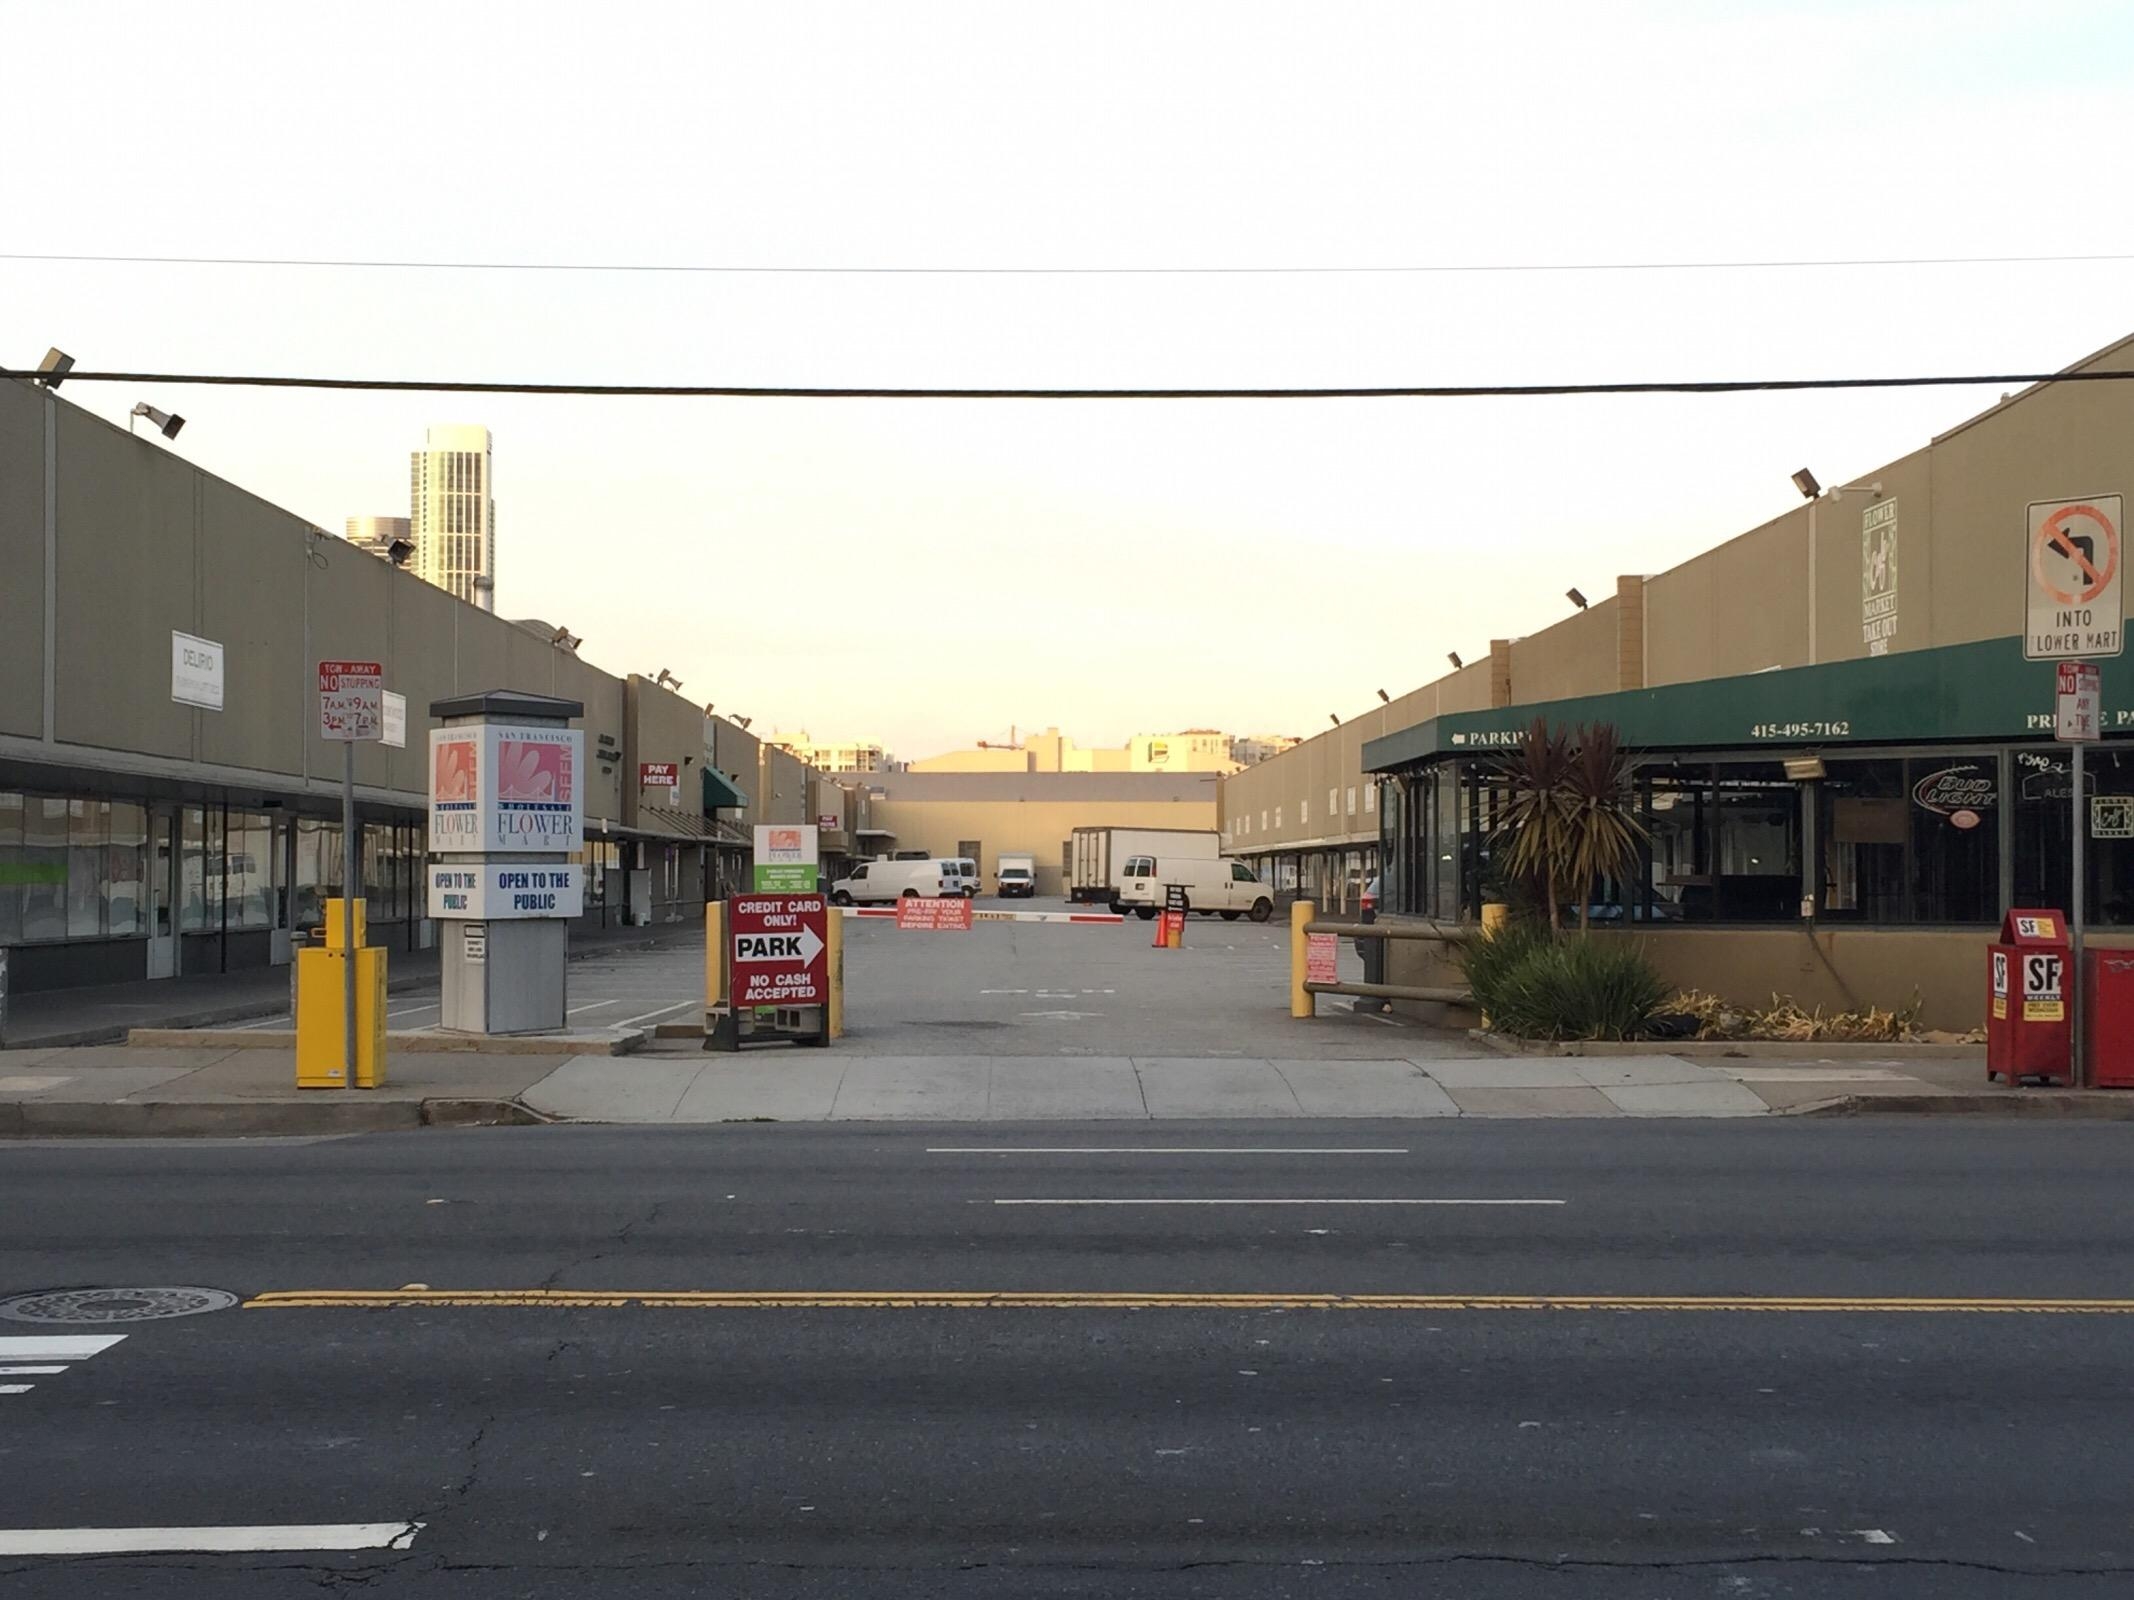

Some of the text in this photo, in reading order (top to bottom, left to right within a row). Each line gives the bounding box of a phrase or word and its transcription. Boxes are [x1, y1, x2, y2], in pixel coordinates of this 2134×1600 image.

[2056, 609, 2092, 628] INTO
[2086, 631, 2118, 649] MART
[320, 674, 338, 690] NO
[2058, 674, 2075, 693] NO
[520, 731, 573, 743] FRANCISCO
[1750, 721, 1850, 738] 415-495-7162
[648, 765, 669, 774] PAY
[643, 775, 674, 785] HERE
[1937, 775, 1991, 791] BUD
[435, 813, 479, 835] FLOWER
[497, 813, 574, 835] FLOWER
[497, 834, 570, 846] MART
[435, 873, 476, 889] OPEN TO THE
[499, 872, 570, 889] OPEN TO THE
[443, 894, 468, 910] PUBLIC
[514, 893, 556, 910] PUBLIC
[738, 900, 821, 914] CREDIT CARD
[904, 899, 965, 908] ATTENTION
[763, 914, 797, 927] ONLY!
[2020, 920, 2036, 933] SF
[737, 937, 802, 958] PARK
[750, 973, 811, 987] NO CASH
[2029, 958, 2060, 991] SF
[745, 986, 816, 1001] ACCEPTED
